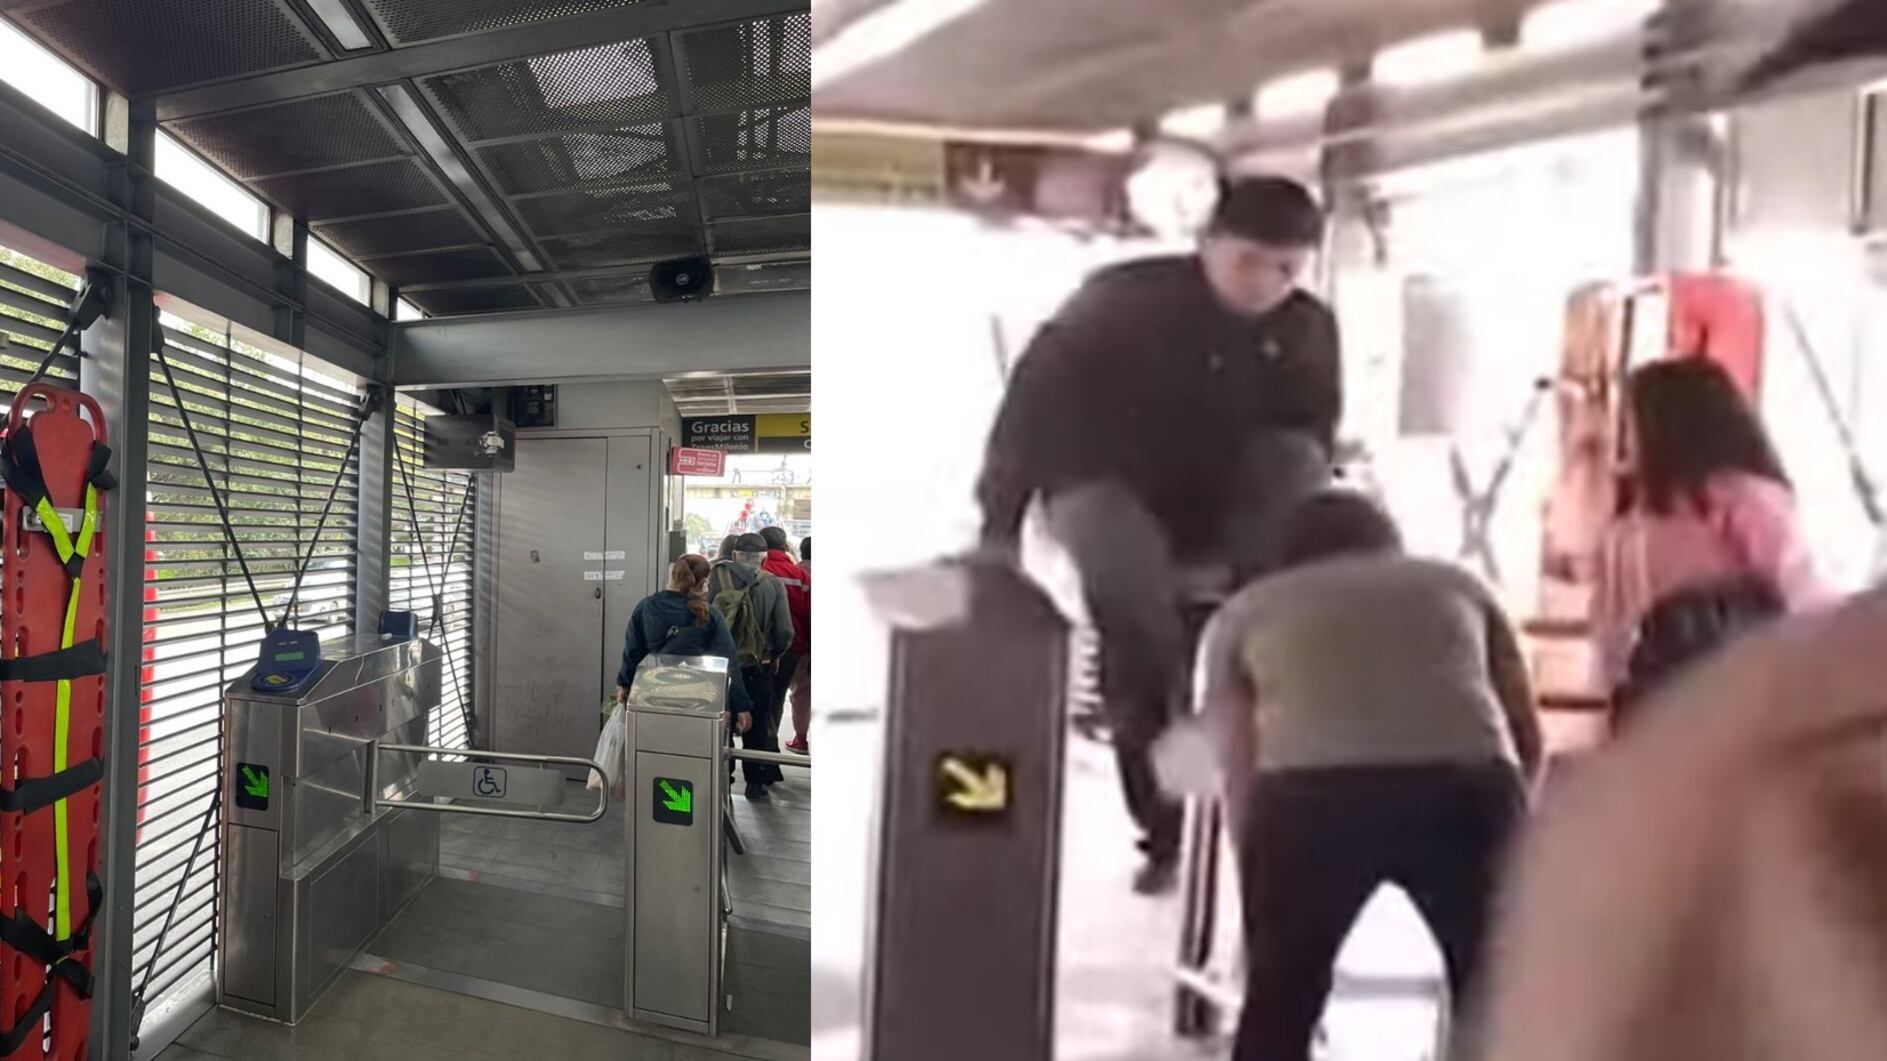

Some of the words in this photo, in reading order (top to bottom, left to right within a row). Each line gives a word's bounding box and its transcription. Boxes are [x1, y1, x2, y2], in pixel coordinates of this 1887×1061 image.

[691, 420, 749, 433] Gracias
[691, 434, 706, 443] por
[708, 433, 731, 442] viajar
